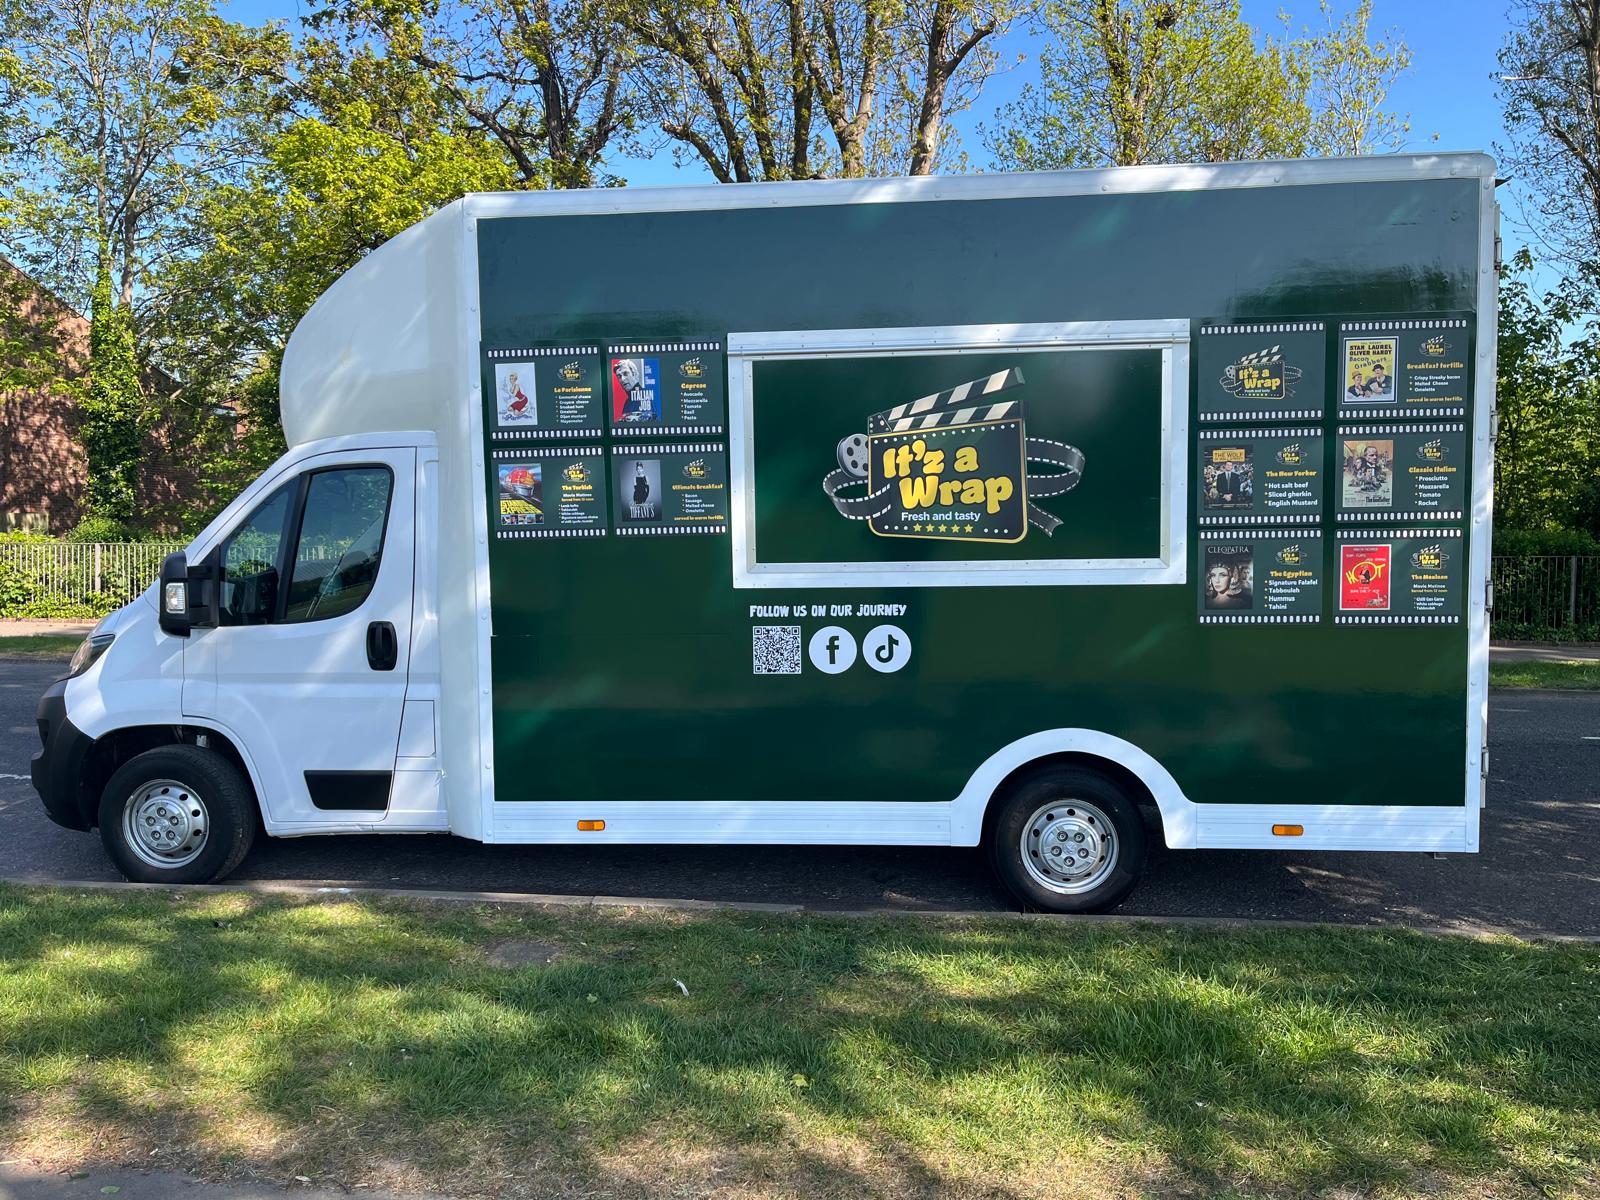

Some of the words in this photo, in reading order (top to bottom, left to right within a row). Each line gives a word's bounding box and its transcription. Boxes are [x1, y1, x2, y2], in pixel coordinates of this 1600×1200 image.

[1262, 369, 1270, 378] a
[1244, 378, 1280, 390] Wrap
[631, 390, 654, 401] ITALIAN
[639, 400, 652, 411] JOB
[883, 439, 945, 479] It'z
[953, 446, 979, 473] a
[899, 475, 1014, 514] Wrap
[901, 512, 930, 521] Fresh
[932, 512, 952, 521] and
[955, 512, 981, 522] tasty
[1208, 546, 1250, 554] CLEOPATRA
[1283, 570, 1312, 578] Egyptian
[750, 605, 790, 618] FOLLOW
[793, 605, 807, 617] US
[812, 605, 826, 617] ON
[830, 604, 852, 617] OUR
[856, 604, 906, 617] JOURNEY
